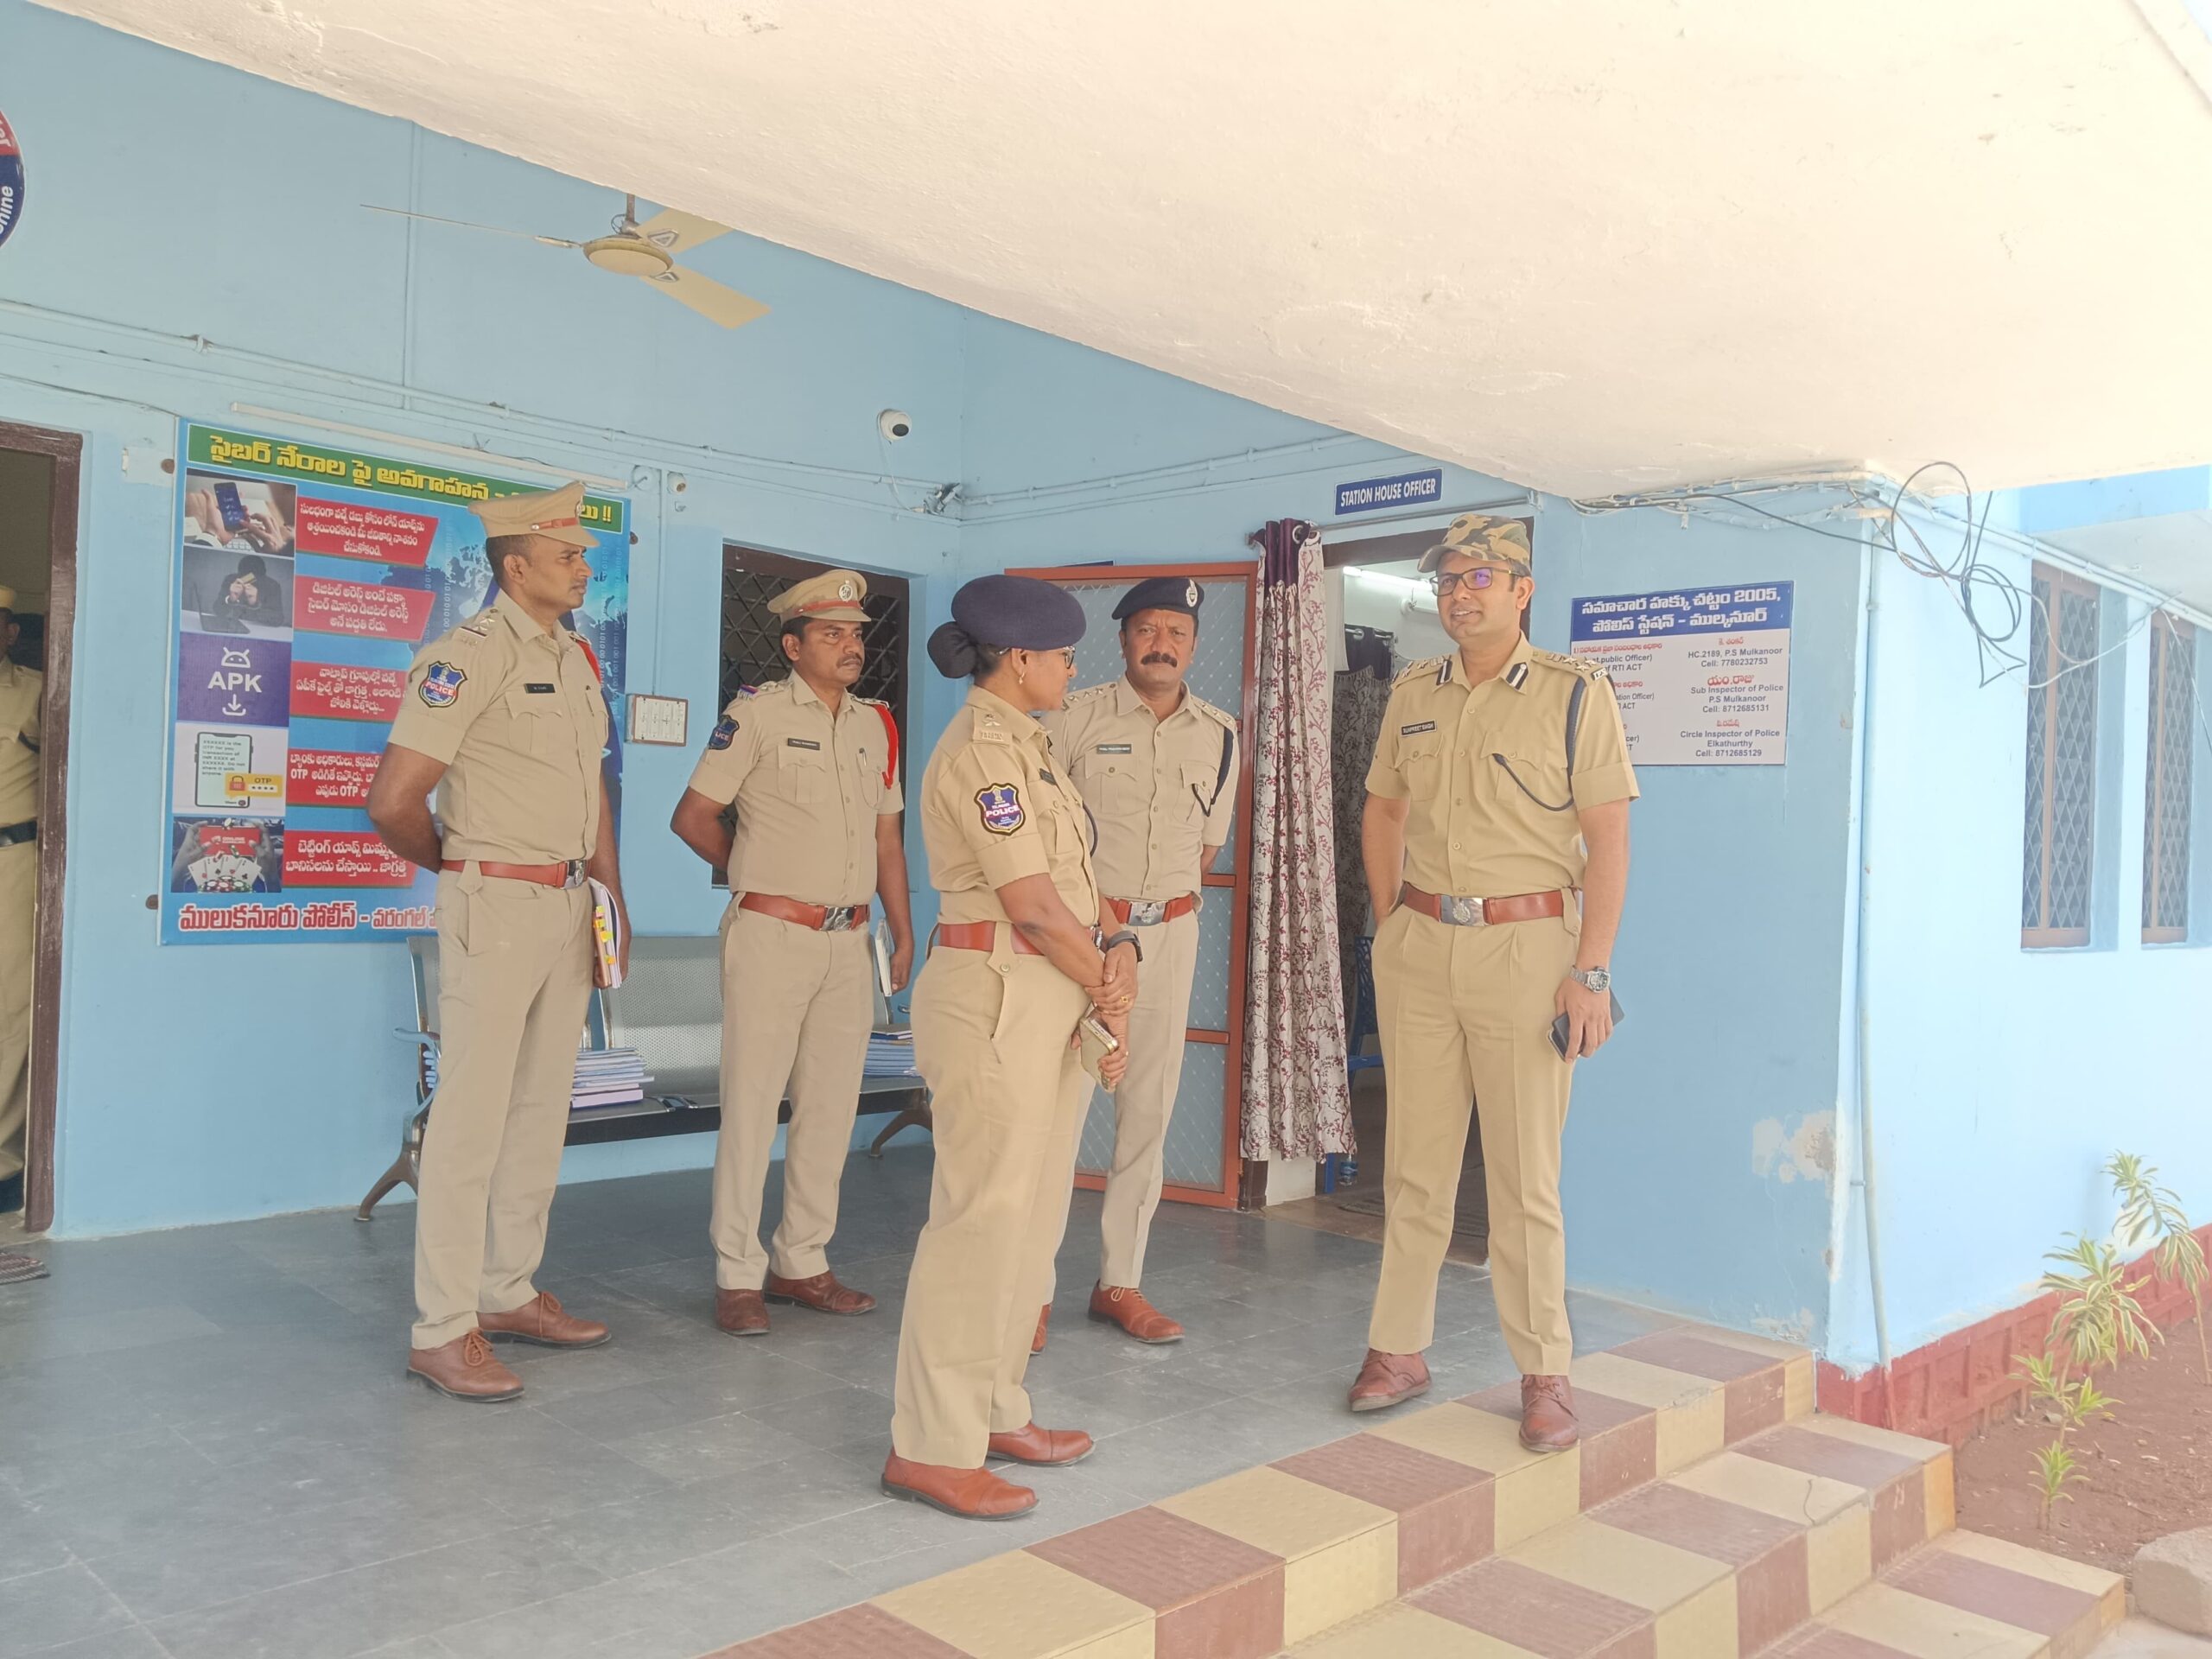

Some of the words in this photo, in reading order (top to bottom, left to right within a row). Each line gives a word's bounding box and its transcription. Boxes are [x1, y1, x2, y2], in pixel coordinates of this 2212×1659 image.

[209, 435, 271, 464] సైబర్
[276, 445, 346, 477] నేరాల
[352, 459, 373, 486] పై
[377, 467, 489, 500] అవగాహన
[1341, 487, 1373, 507] STATION
[1374, 483, 1402, 502] HOUSE
[1403, 478, 1435, 498] OFFICER
[1582, 598, 1647, 614] సమాచార
[1649, 594, 1692, 611] హక్కు
[1692, 592, 1731, 611] చట్టం
[1734, 588, 1781, 603] 2005,
[1637, 614, 1675, 635] స్టేషన్
[207, 671, 262, 693] APK
[425, 681, 454, 696] POLICE
[1708, 685, 1746, 695] Inspector
[1705, 730, 1743, 739] Inspector
[1707, 740, 1753, 748] Elkathurthy
[290, 769, 308, 779] OTP
[340, 785, 359, 797] OTP
[986, 804, 1020, 817] POLICE
[180, 904, 298, 930] ములుకనూరు
[302, 902, 356, 929] పోలీస్
[372, 908, 427, 927] వరంగల్
